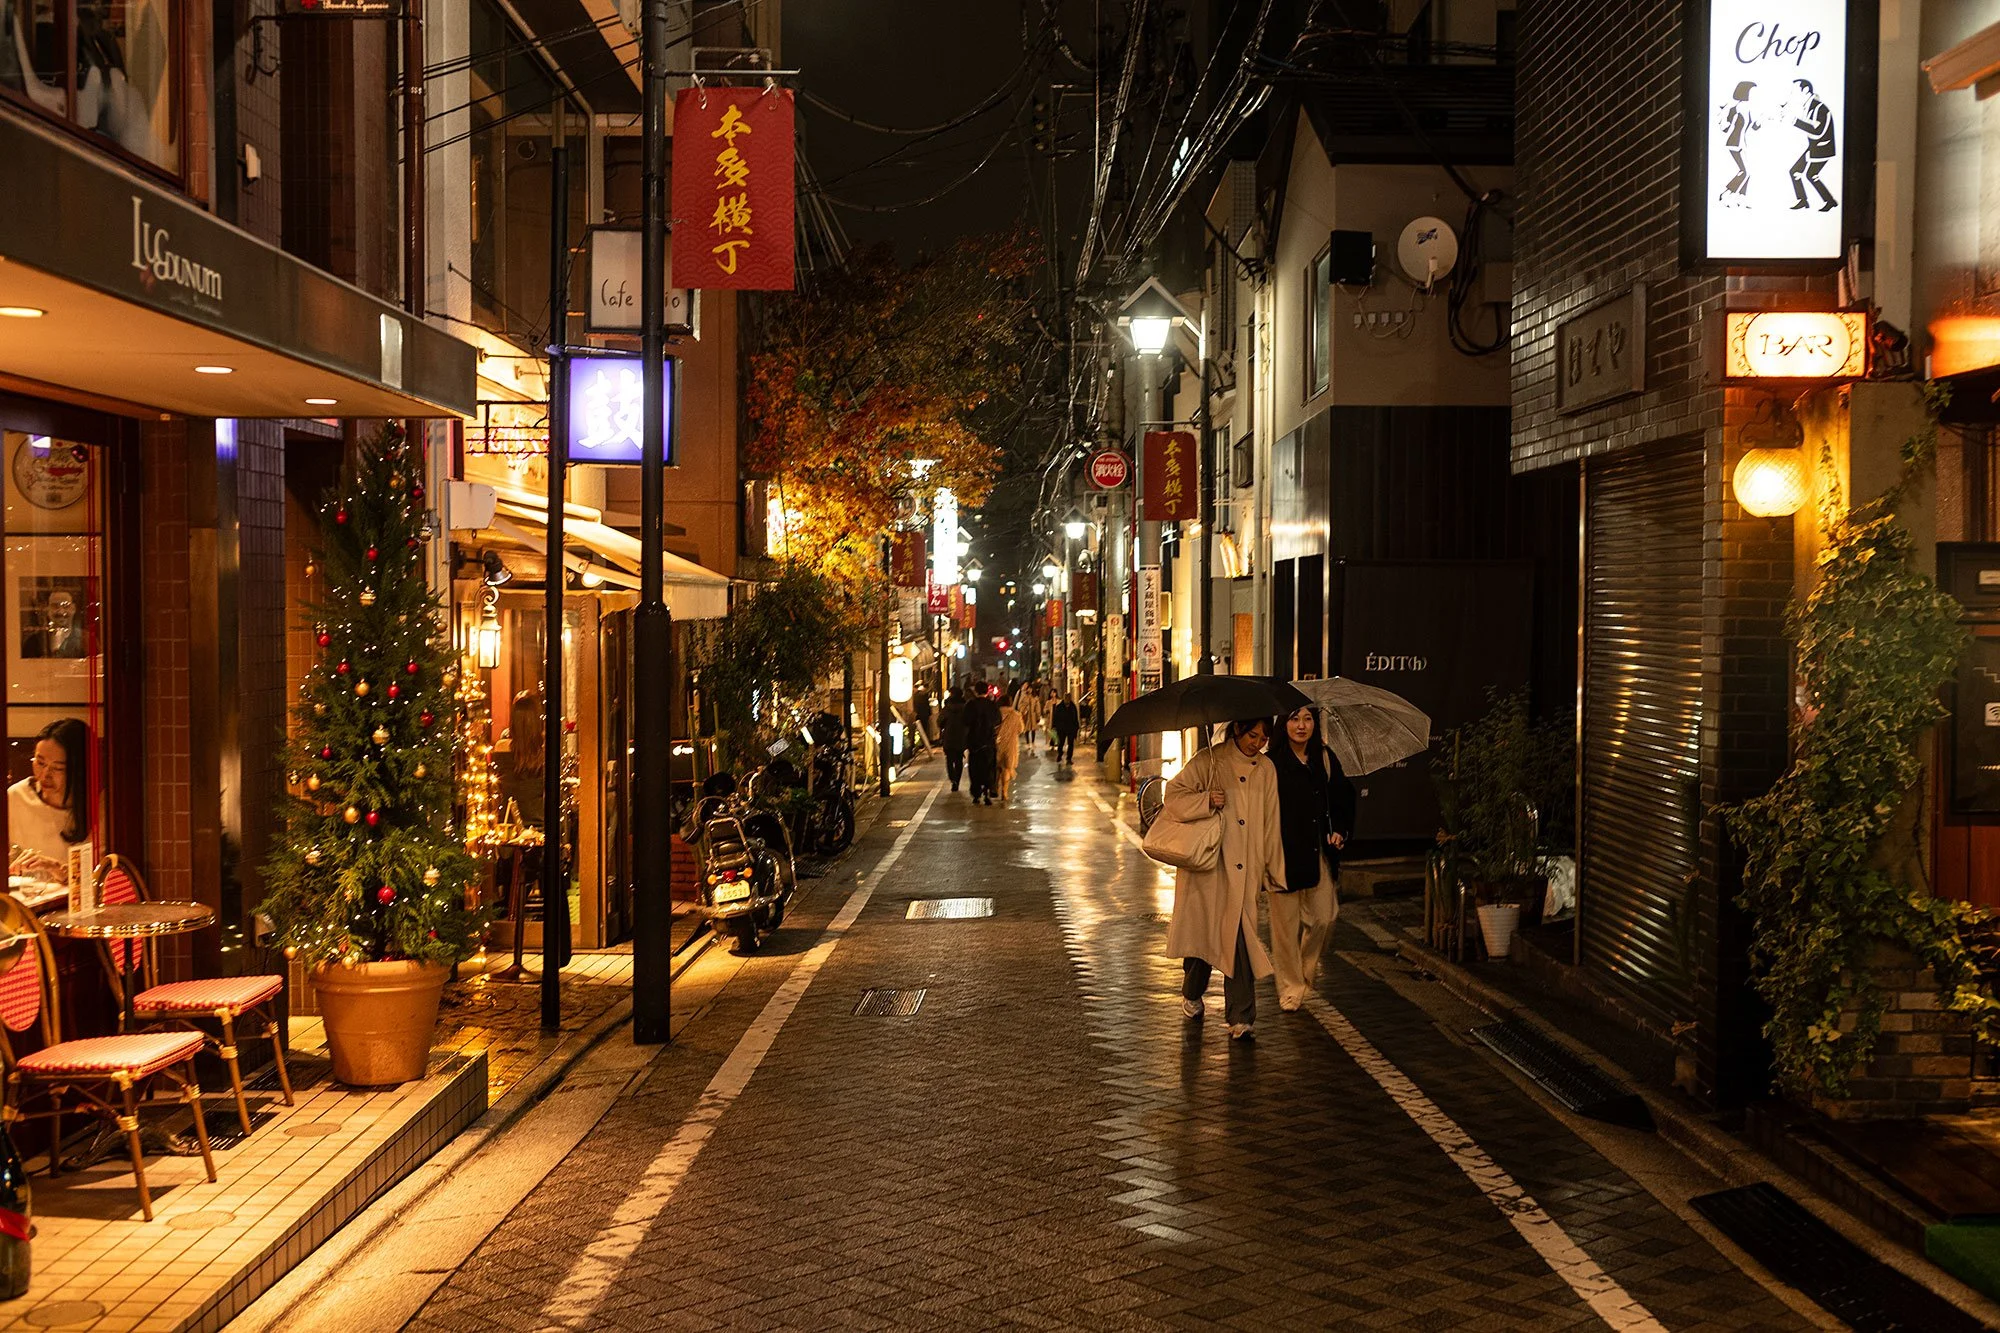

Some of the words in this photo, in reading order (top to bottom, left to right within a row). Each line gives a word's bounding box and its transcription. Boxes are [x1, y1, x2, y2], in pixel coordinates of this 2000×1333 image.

[1735, 21, 1821, 66] Chop
[709, 103, 753, 276] 本多横丁
[1760, 333, 1833, 357] BAR
[1095, 463, 1124, 478] 消火栓
[1162, 438, 1184, 516] 本多横丁
[1365, 651, 1428, 671] ÉDIT(h)
